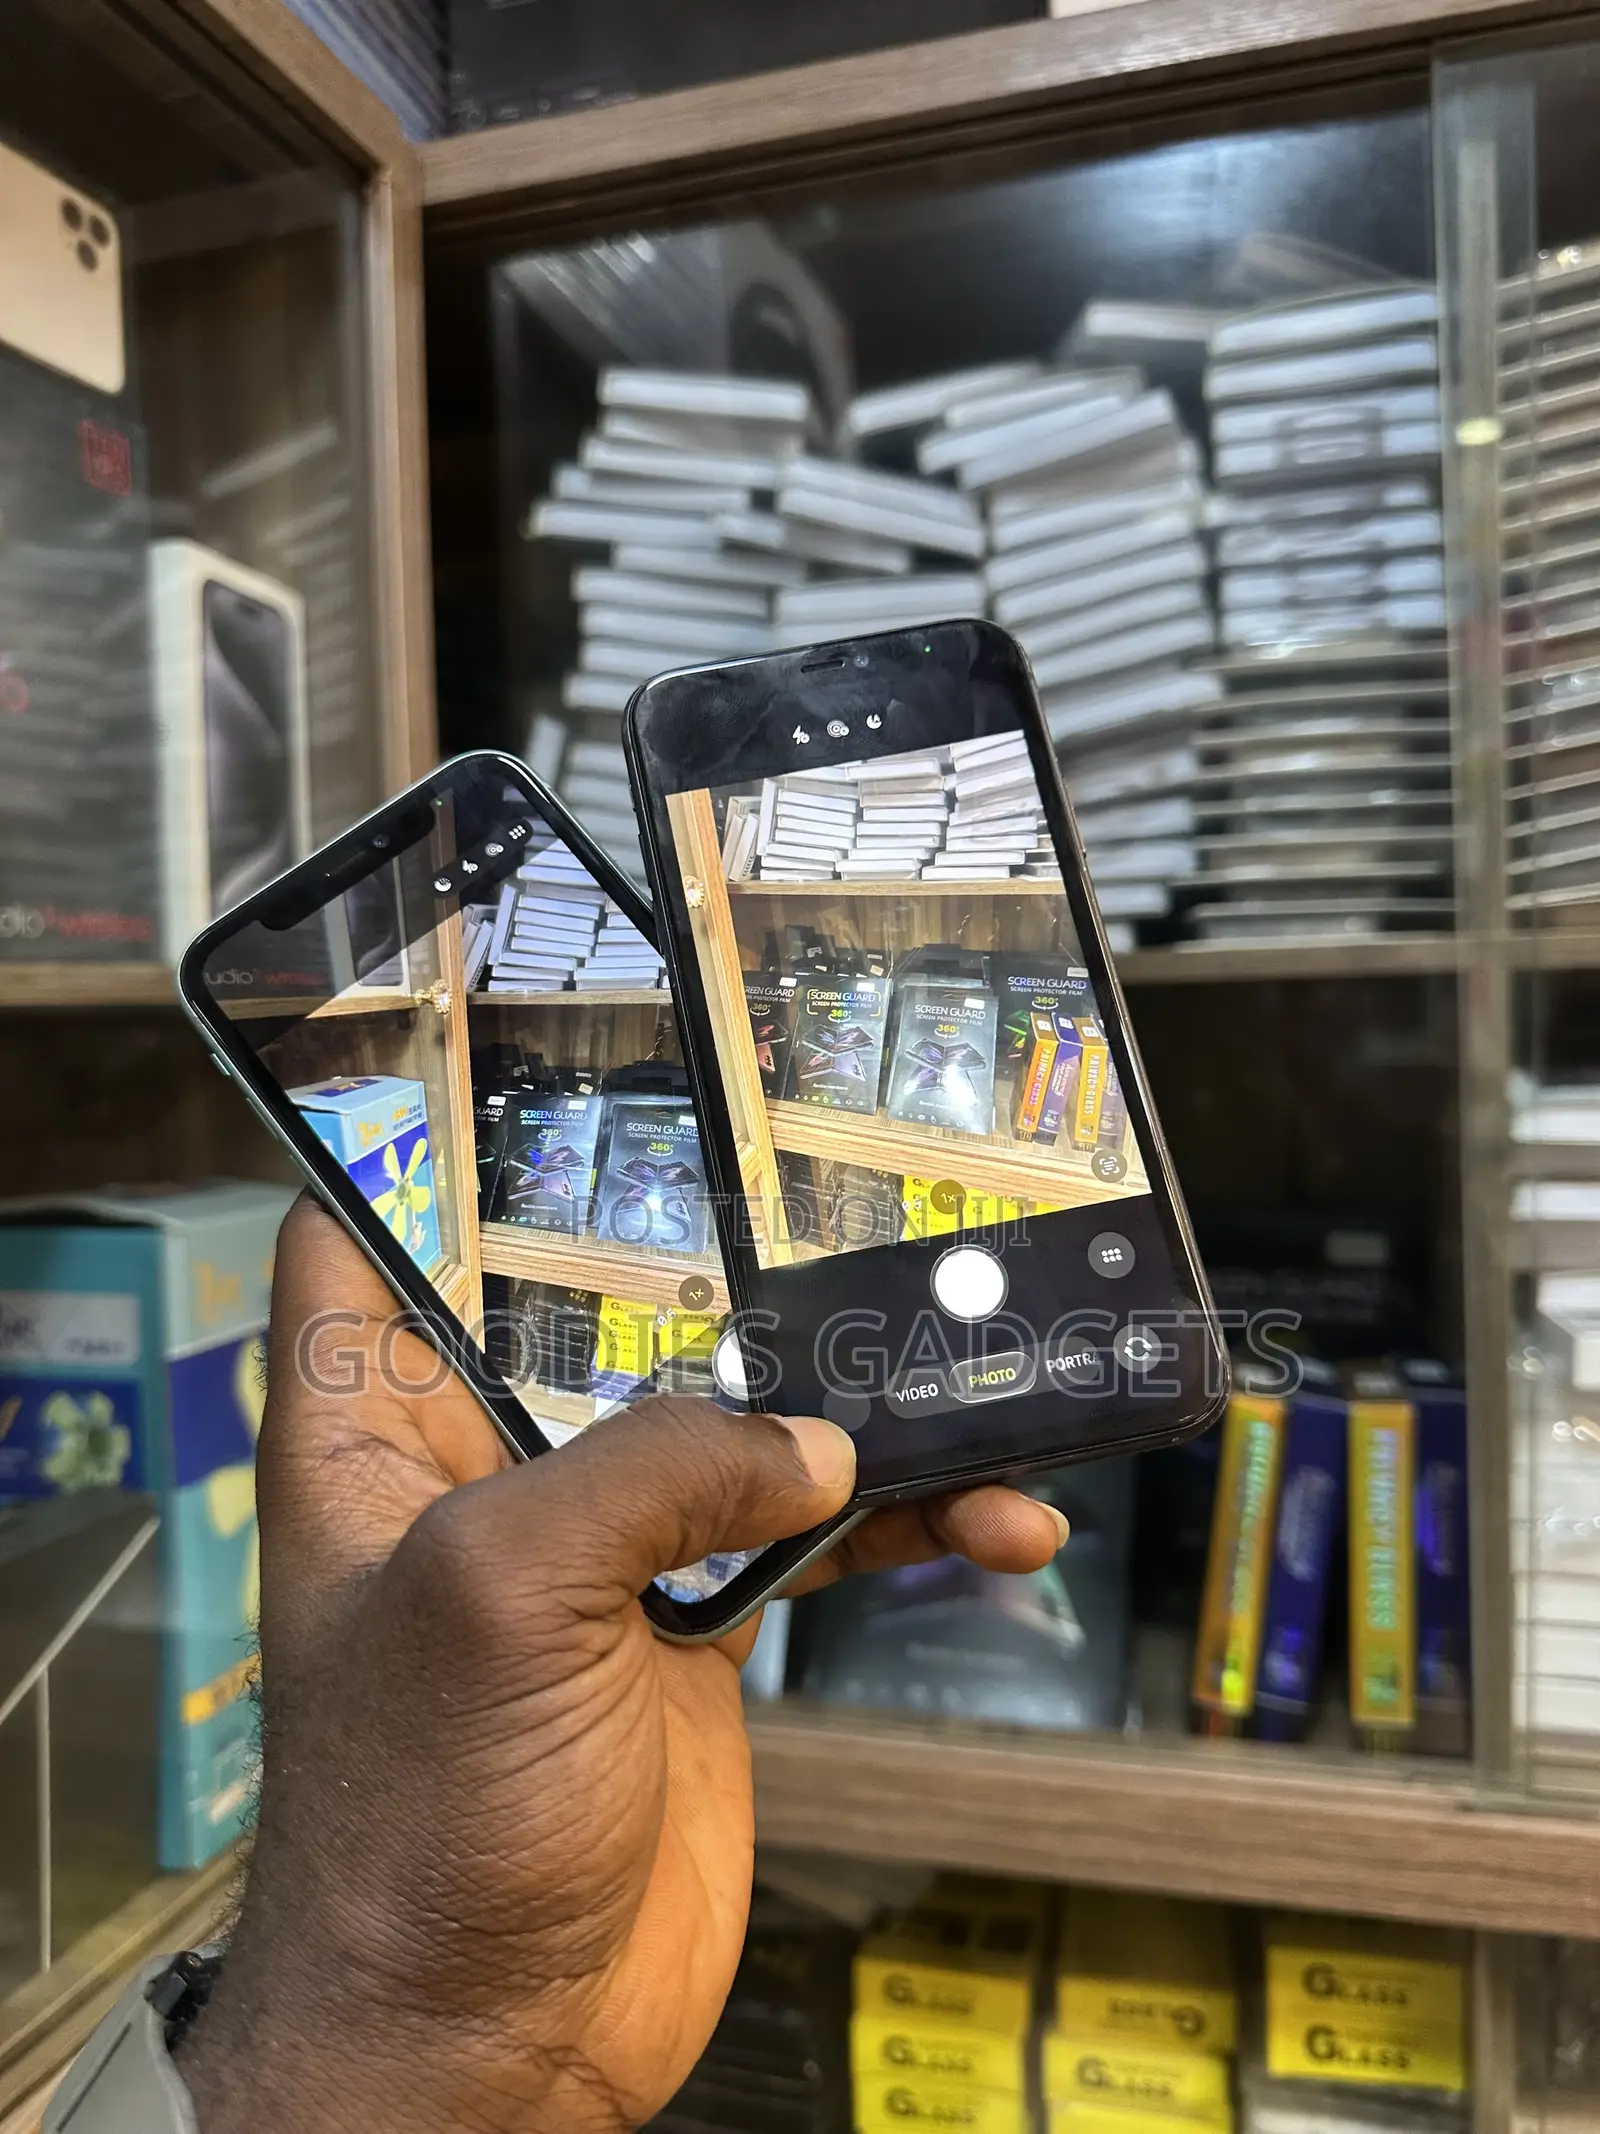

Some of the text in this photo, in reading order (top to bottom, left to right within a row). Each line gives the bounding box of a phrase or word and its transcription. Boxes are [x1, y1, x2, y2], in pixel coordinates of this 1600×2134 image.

[1008, 976, 1086, 990] SCREEN GUARD
[764, 986, 795, 997] GUARD
[810, 991, 876, 1002] SCREEN GUARD
[915, 1004, 986, 1020] SCREEN GUARD
[1087, 1054, 1100, 1088] PRIVACY
[520, 1109, 588, 1120] SCREEN GUARD
[626, 1122, 662, 1133] SCREEN
[610, 1318, 638, 1329] GLASS
[896, 1384, 939, 1402] VIDEO
[968, 1378, 1016, 1398] PHOTO
